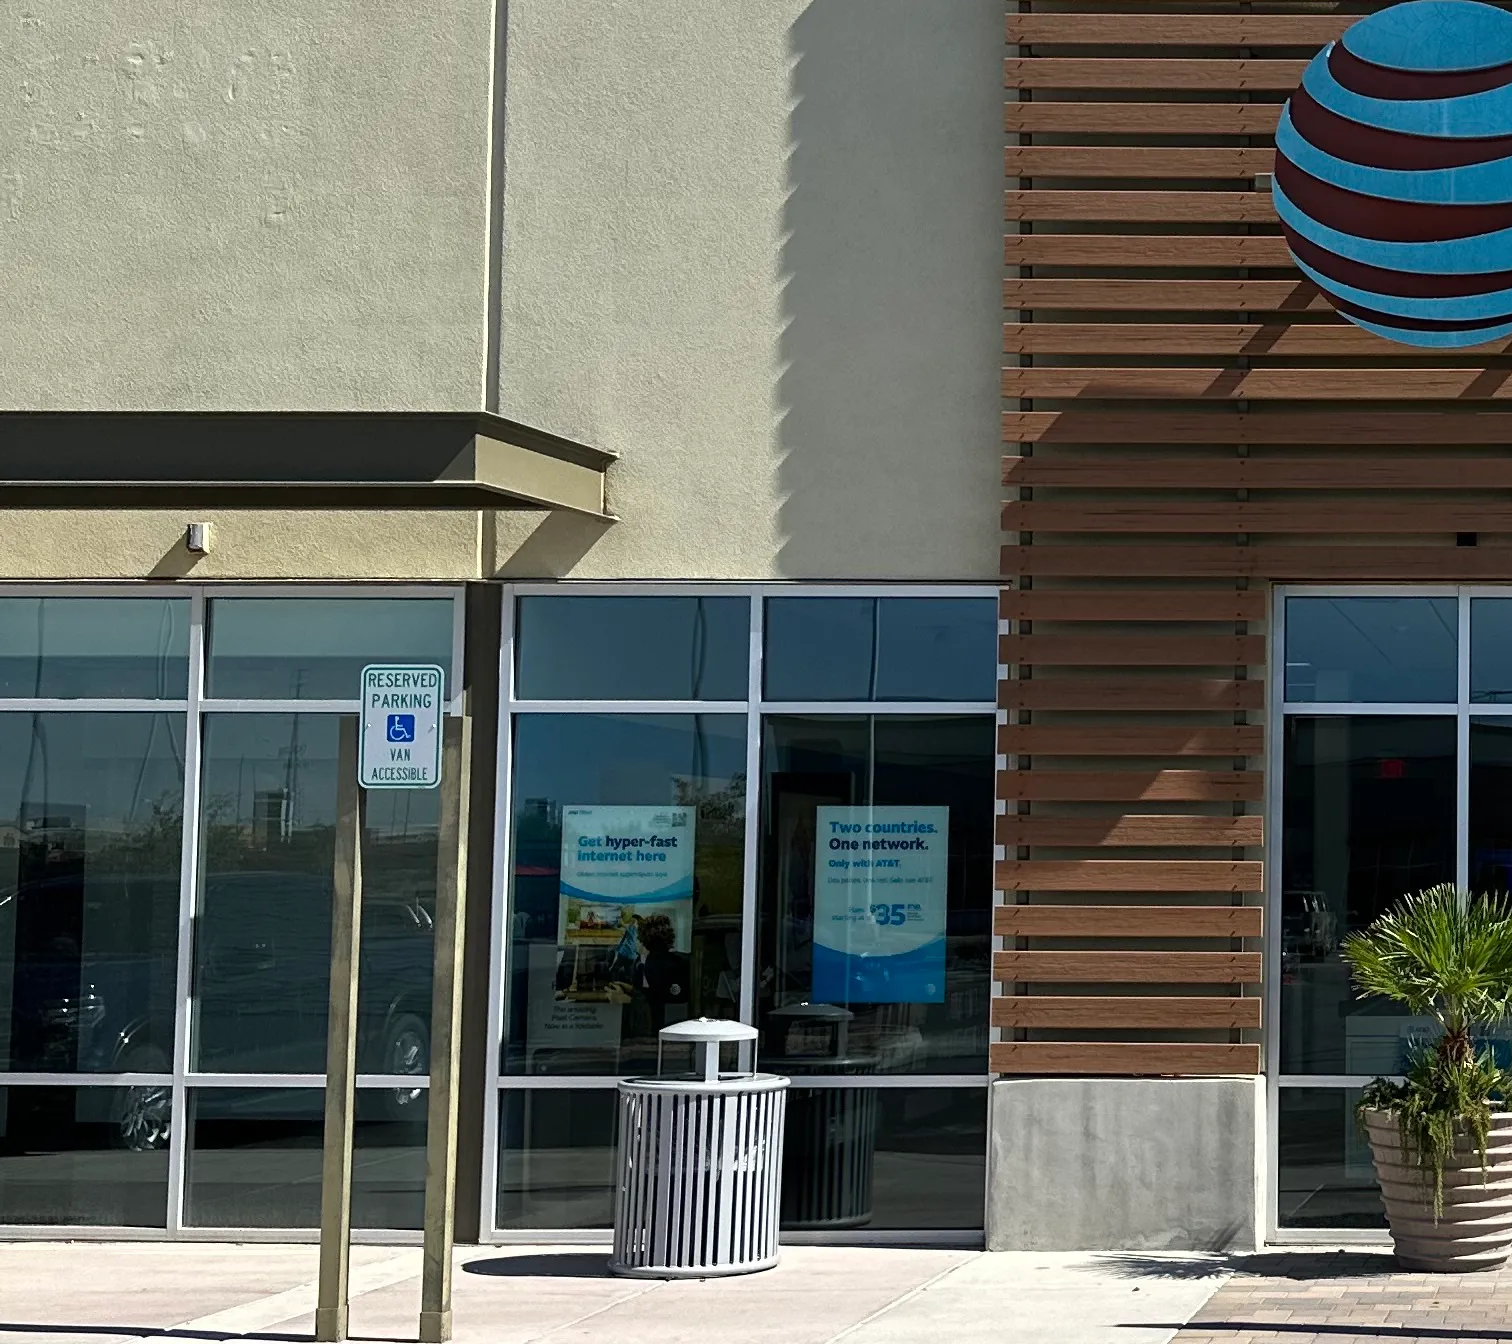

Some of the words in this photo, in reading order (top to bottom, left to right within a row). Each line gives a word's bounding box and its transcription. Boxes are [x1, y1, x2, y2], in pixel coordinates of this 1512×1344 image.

[368, 672, 437, 688] RESERVED
[371, 693, 432, 709] PARKING
[390, 748, 411, 762] VAN
[371, 767, 428, 781] ACCESSIBLE
[829, 821, 862, 833] Two
[865, 820, 938, 834] countries.
[578, 836, 602, 847] Get
[605, 835, 678, 850] hyper-fast
[829, 837, 859, 850] One
[862, 837, 929, 850] network.
[577, 850, 632, 862] internet
[636, 850, 667, 862] here
[829, 859, 850, 870] Only
